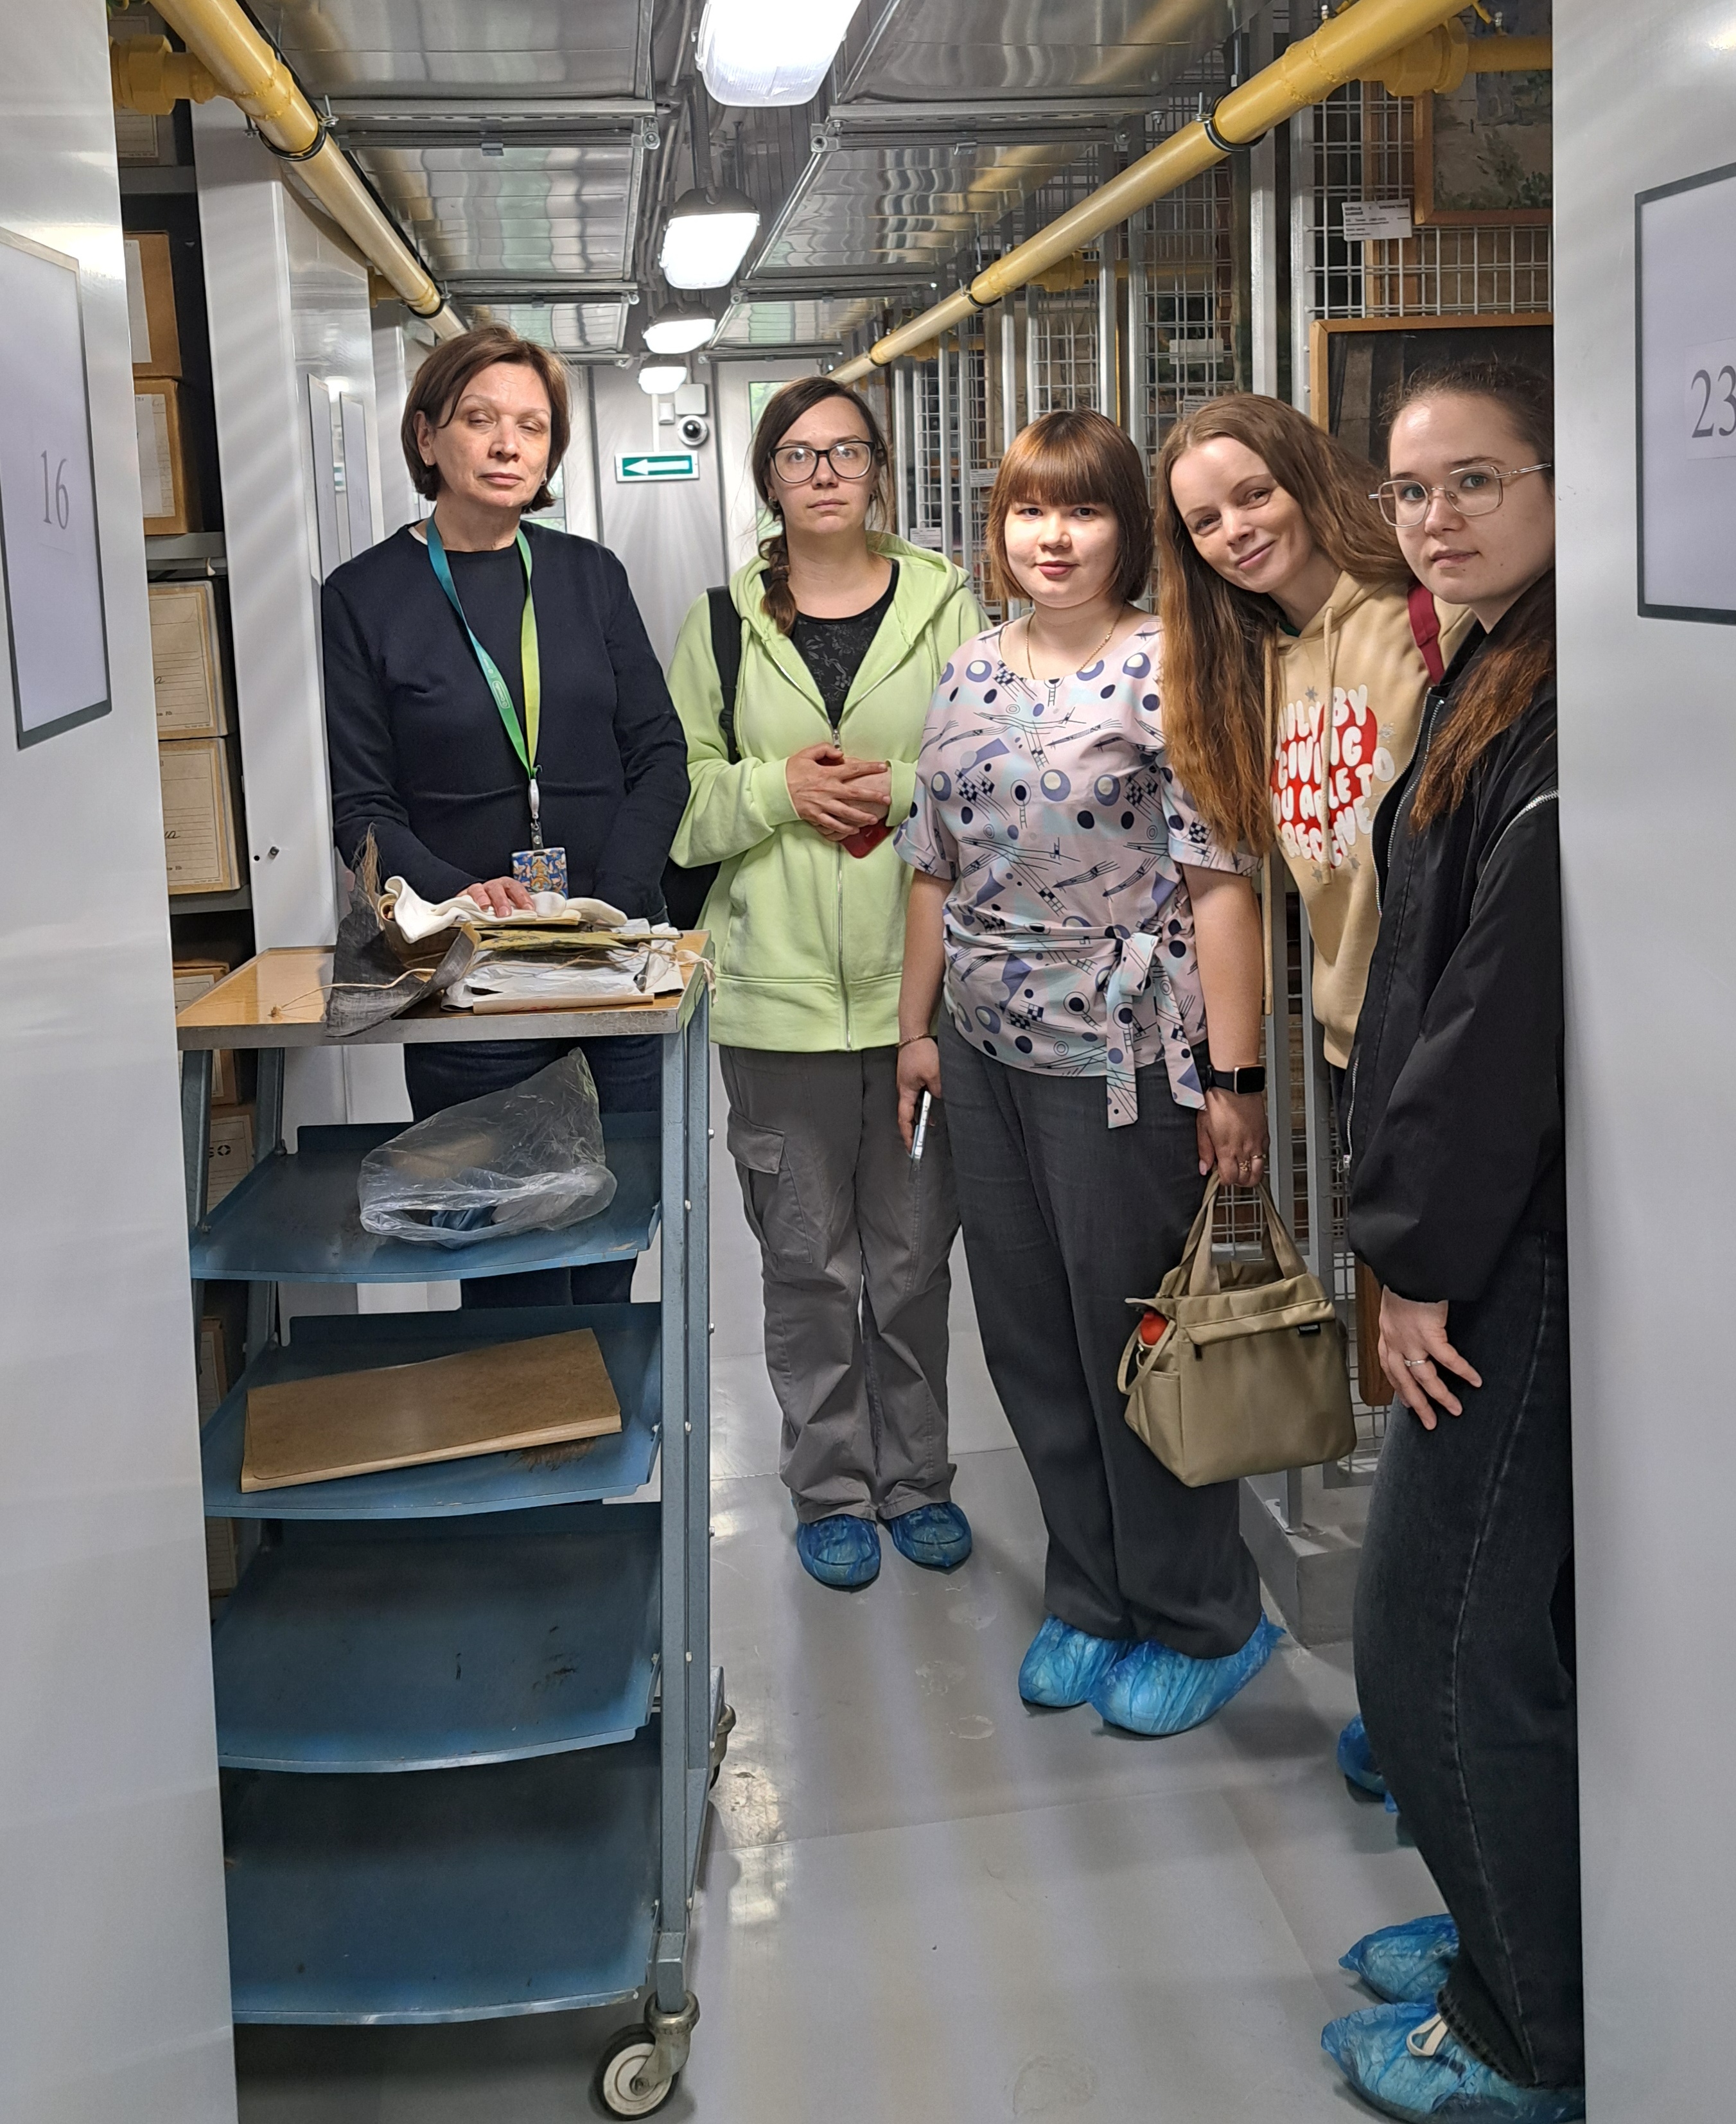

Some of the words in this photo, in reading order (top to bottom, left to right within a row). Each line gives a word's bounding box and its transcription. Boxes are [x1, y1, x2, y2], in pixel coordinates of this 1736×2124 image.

[1691, 365, 1736, 438] 23
[41, 450, 69, 530] 16
[1331, 684, 1368, 727] BY
[1299, 784, 1316, 821] A
